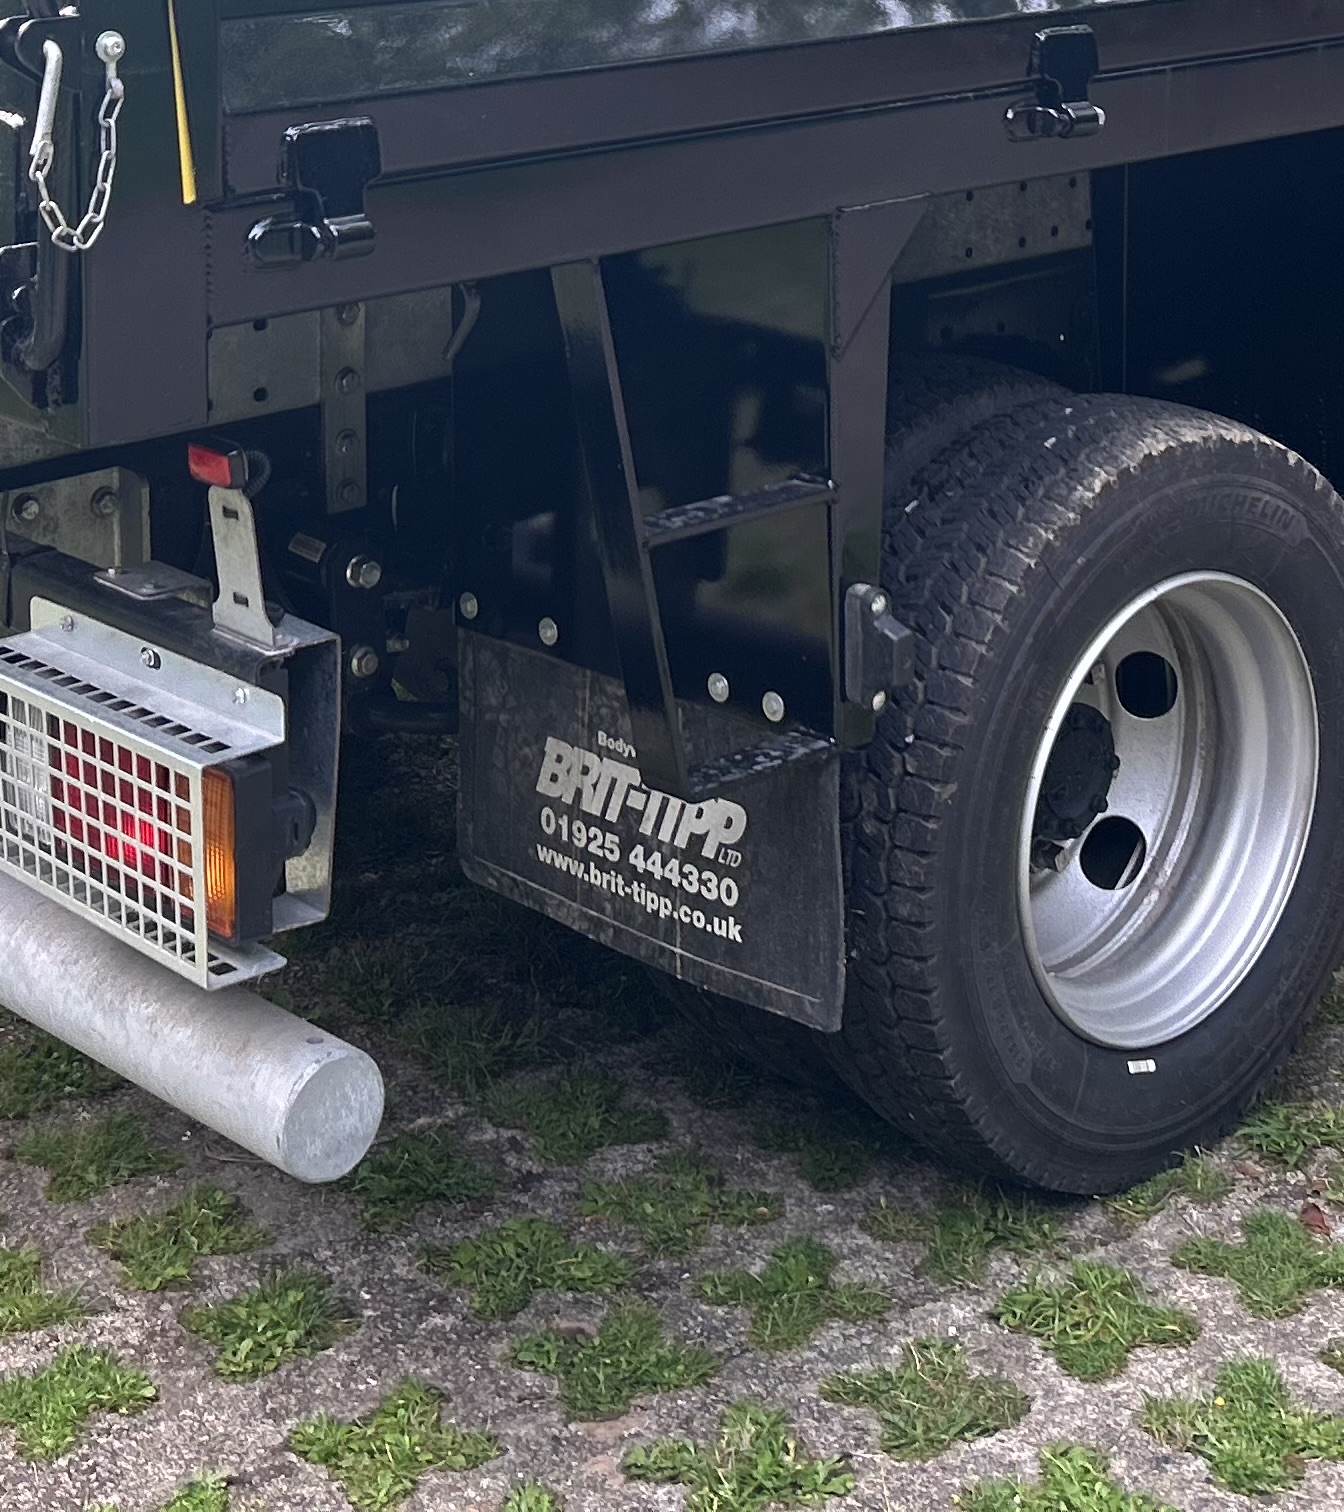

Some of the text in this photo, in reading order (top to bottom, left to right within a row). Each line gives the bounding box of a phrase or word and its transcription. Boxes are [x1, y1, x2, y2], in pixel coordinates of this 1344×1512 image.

[1182, 489, 1297, 530] MICHELIN
[536, 736, 747, 868] BRIT-TIPP LTD
[536, 843, 743, 943] www.brit-tipp.co.uk
[540, 806, 740, 907] 01925 444330
